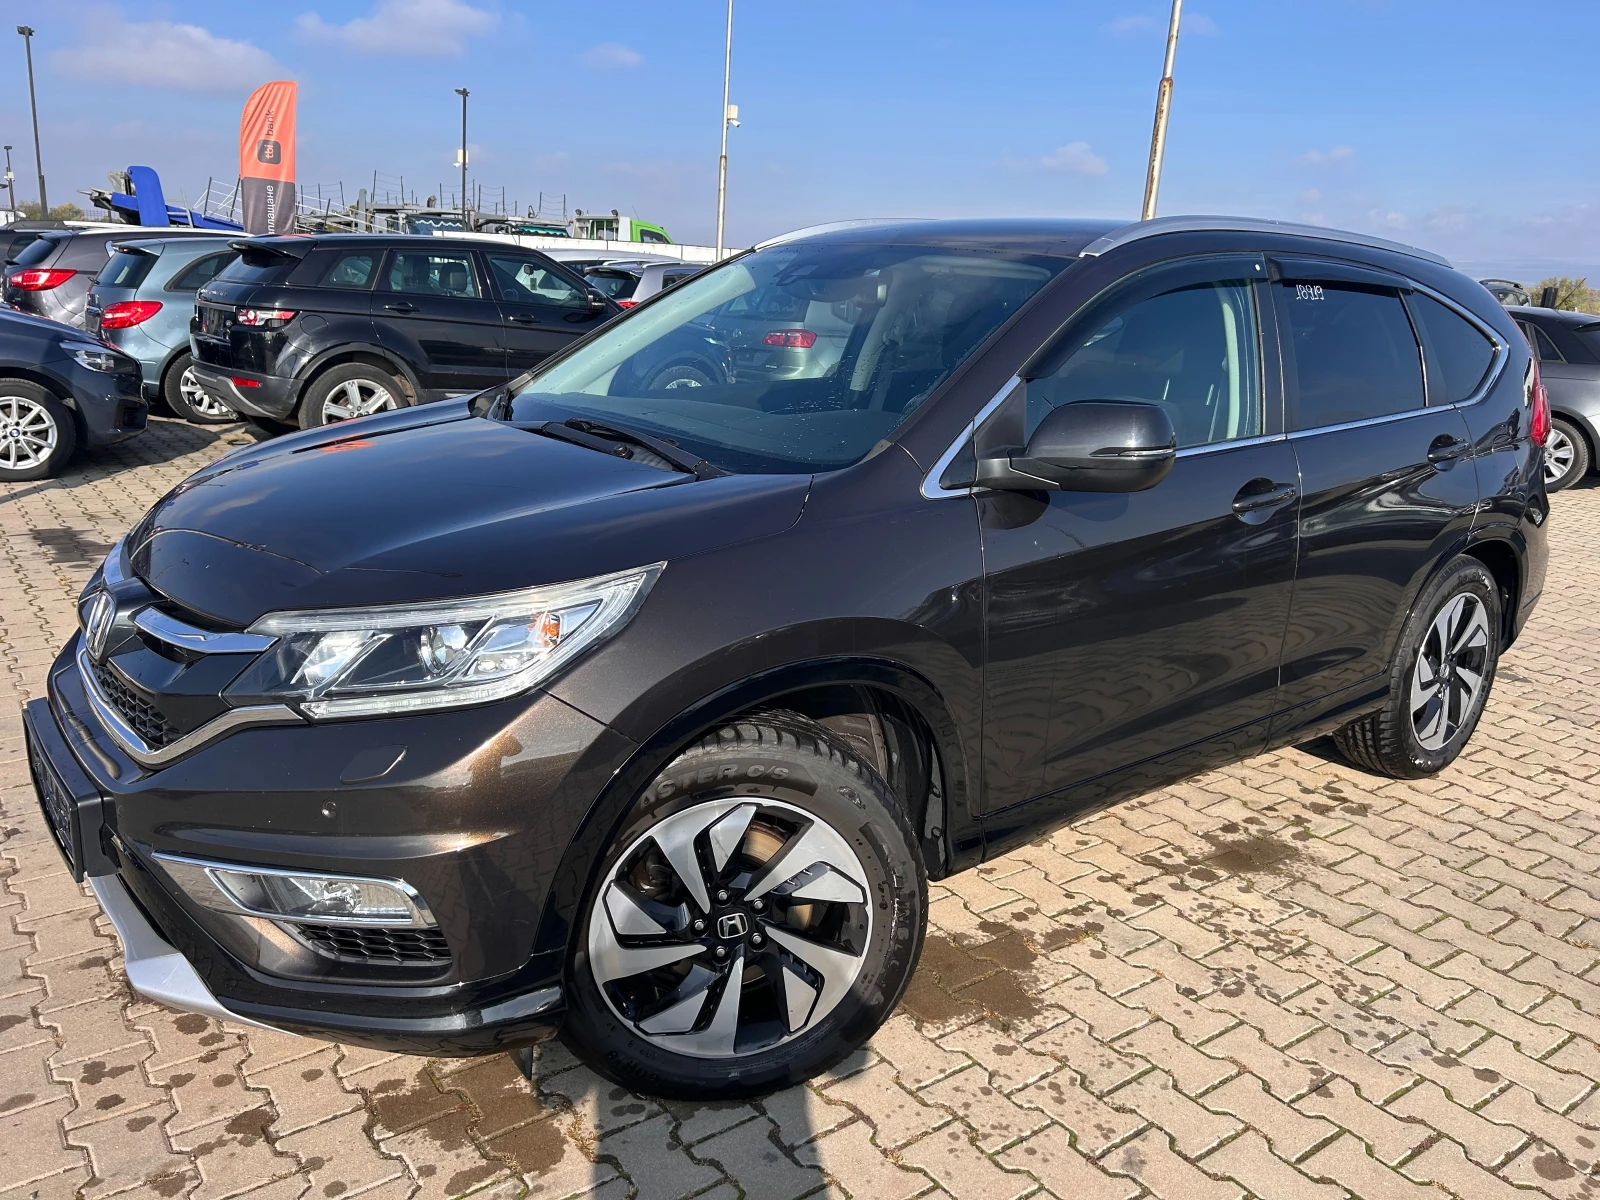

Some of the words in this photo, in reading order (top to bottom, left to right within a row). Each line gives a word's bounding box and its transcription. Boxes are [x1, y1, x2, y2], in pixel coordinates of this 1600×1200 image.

[265, 110, 274, 136] bank
[264, 144, 274, 160] tbi
[639, 763, 739, 809] ASTER
